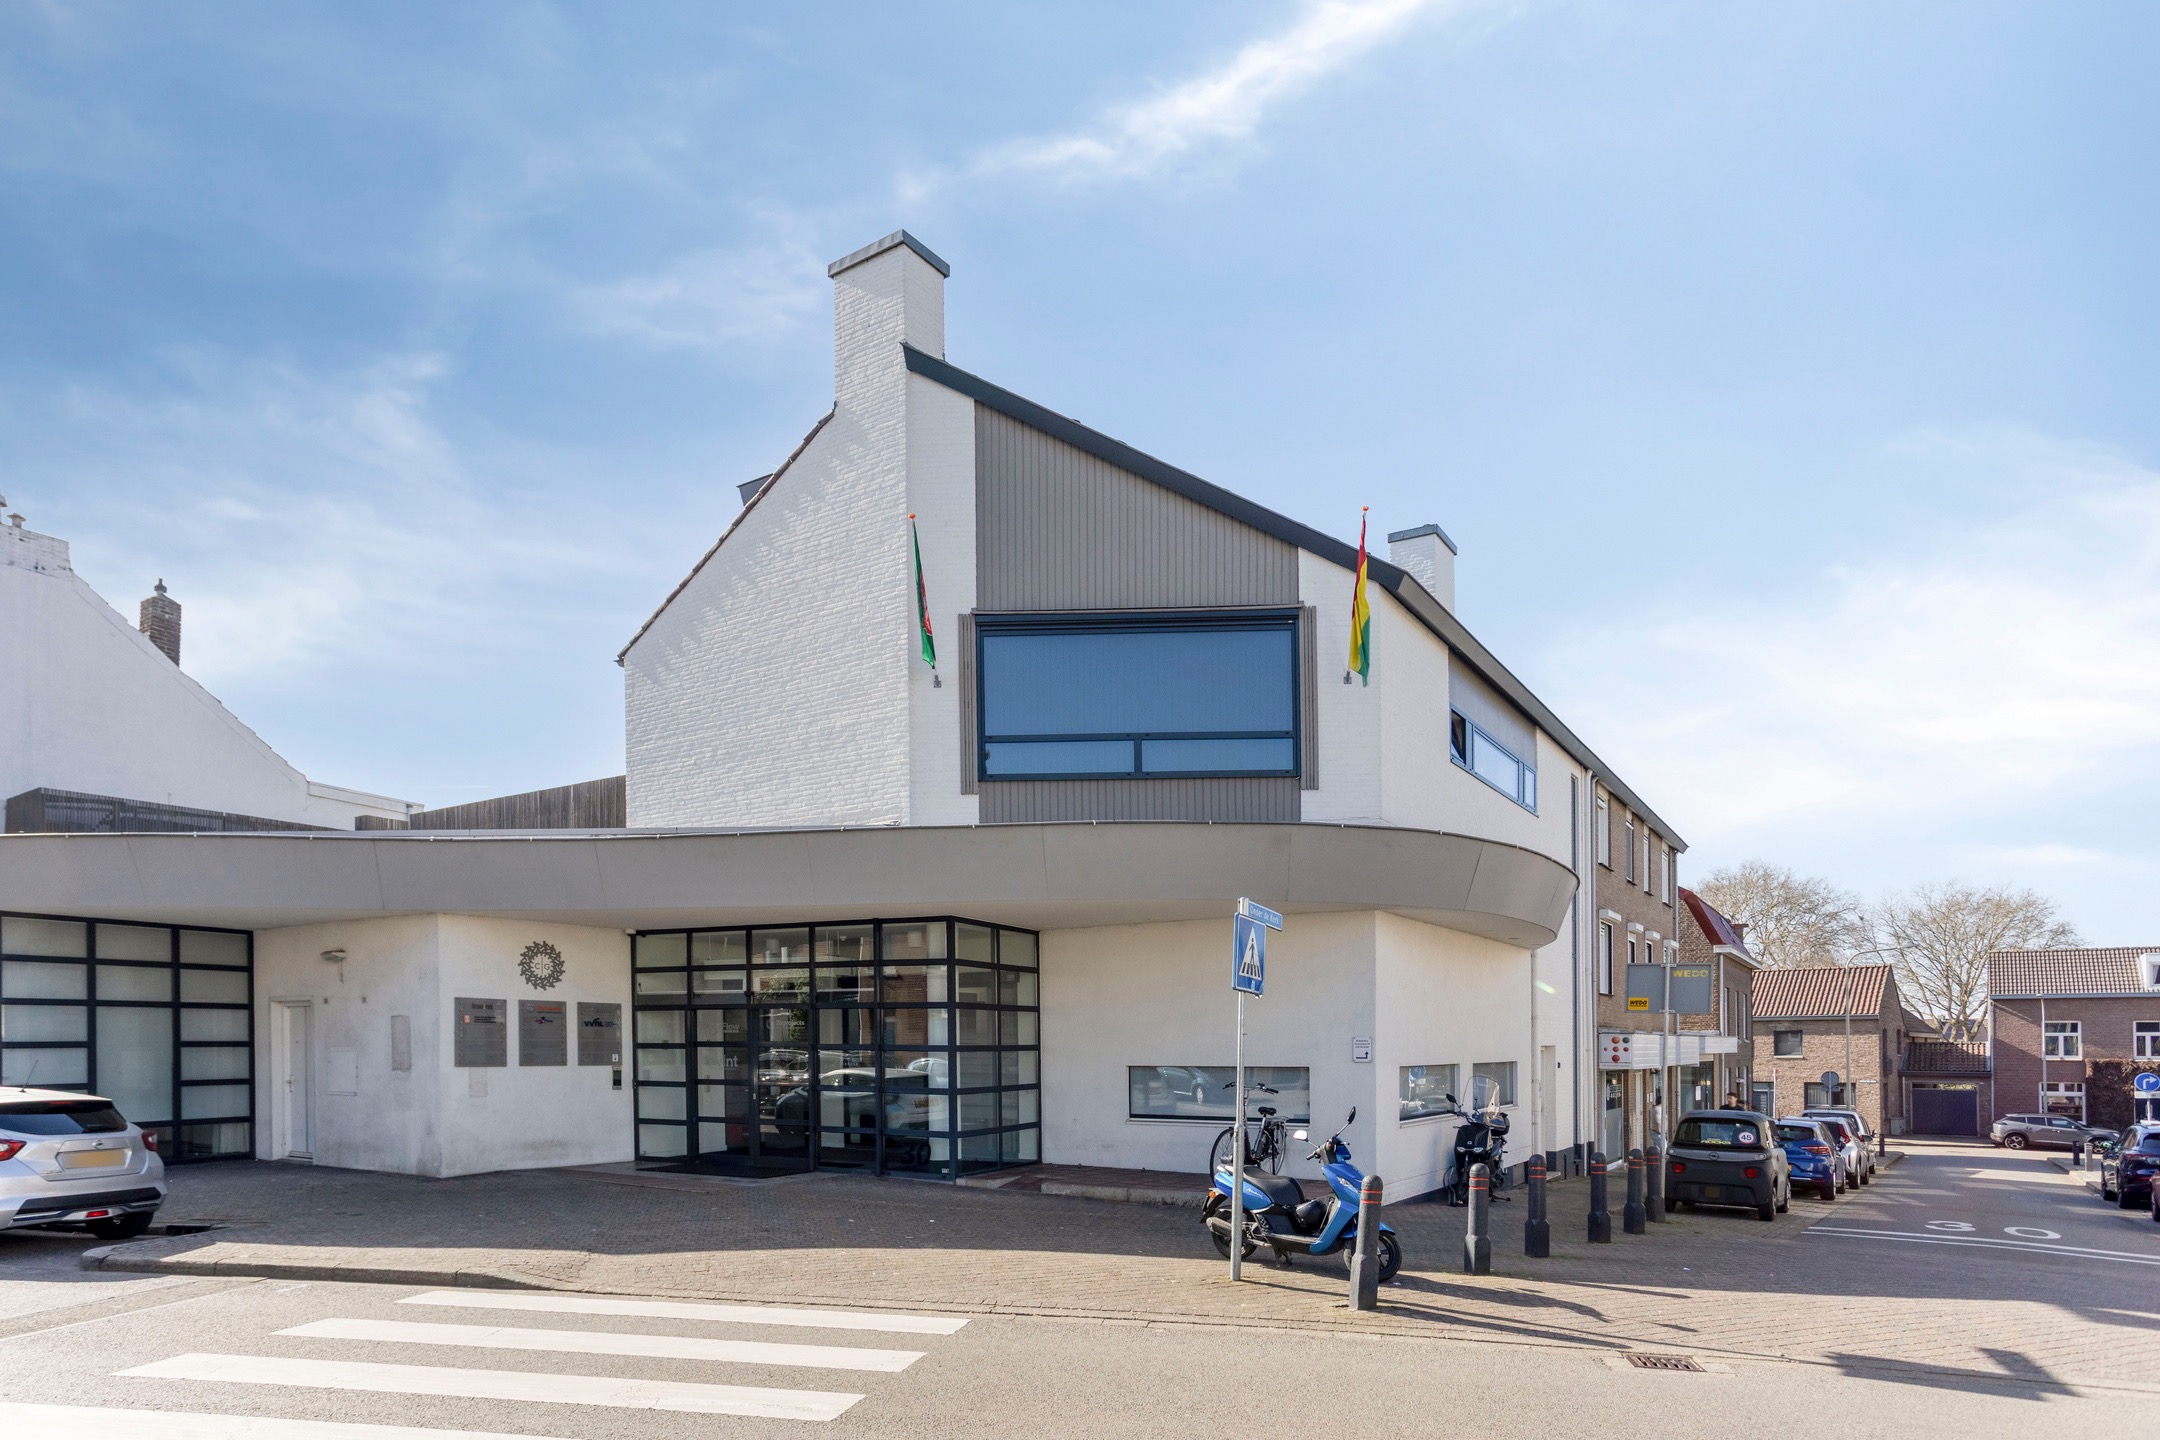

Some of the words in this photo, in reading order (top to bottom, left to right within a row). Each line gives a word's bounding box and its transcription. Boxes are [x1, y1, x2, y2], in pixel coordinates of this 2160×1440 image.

[1250, 905, 1263, 918] Onder
[1270, 914, 1279, 924] Kerk
[1672, 969, 1709, 978] WEDO
[900, 1142, 931, 1166] 30
[1924, 1220, 2061, 1239] 30
